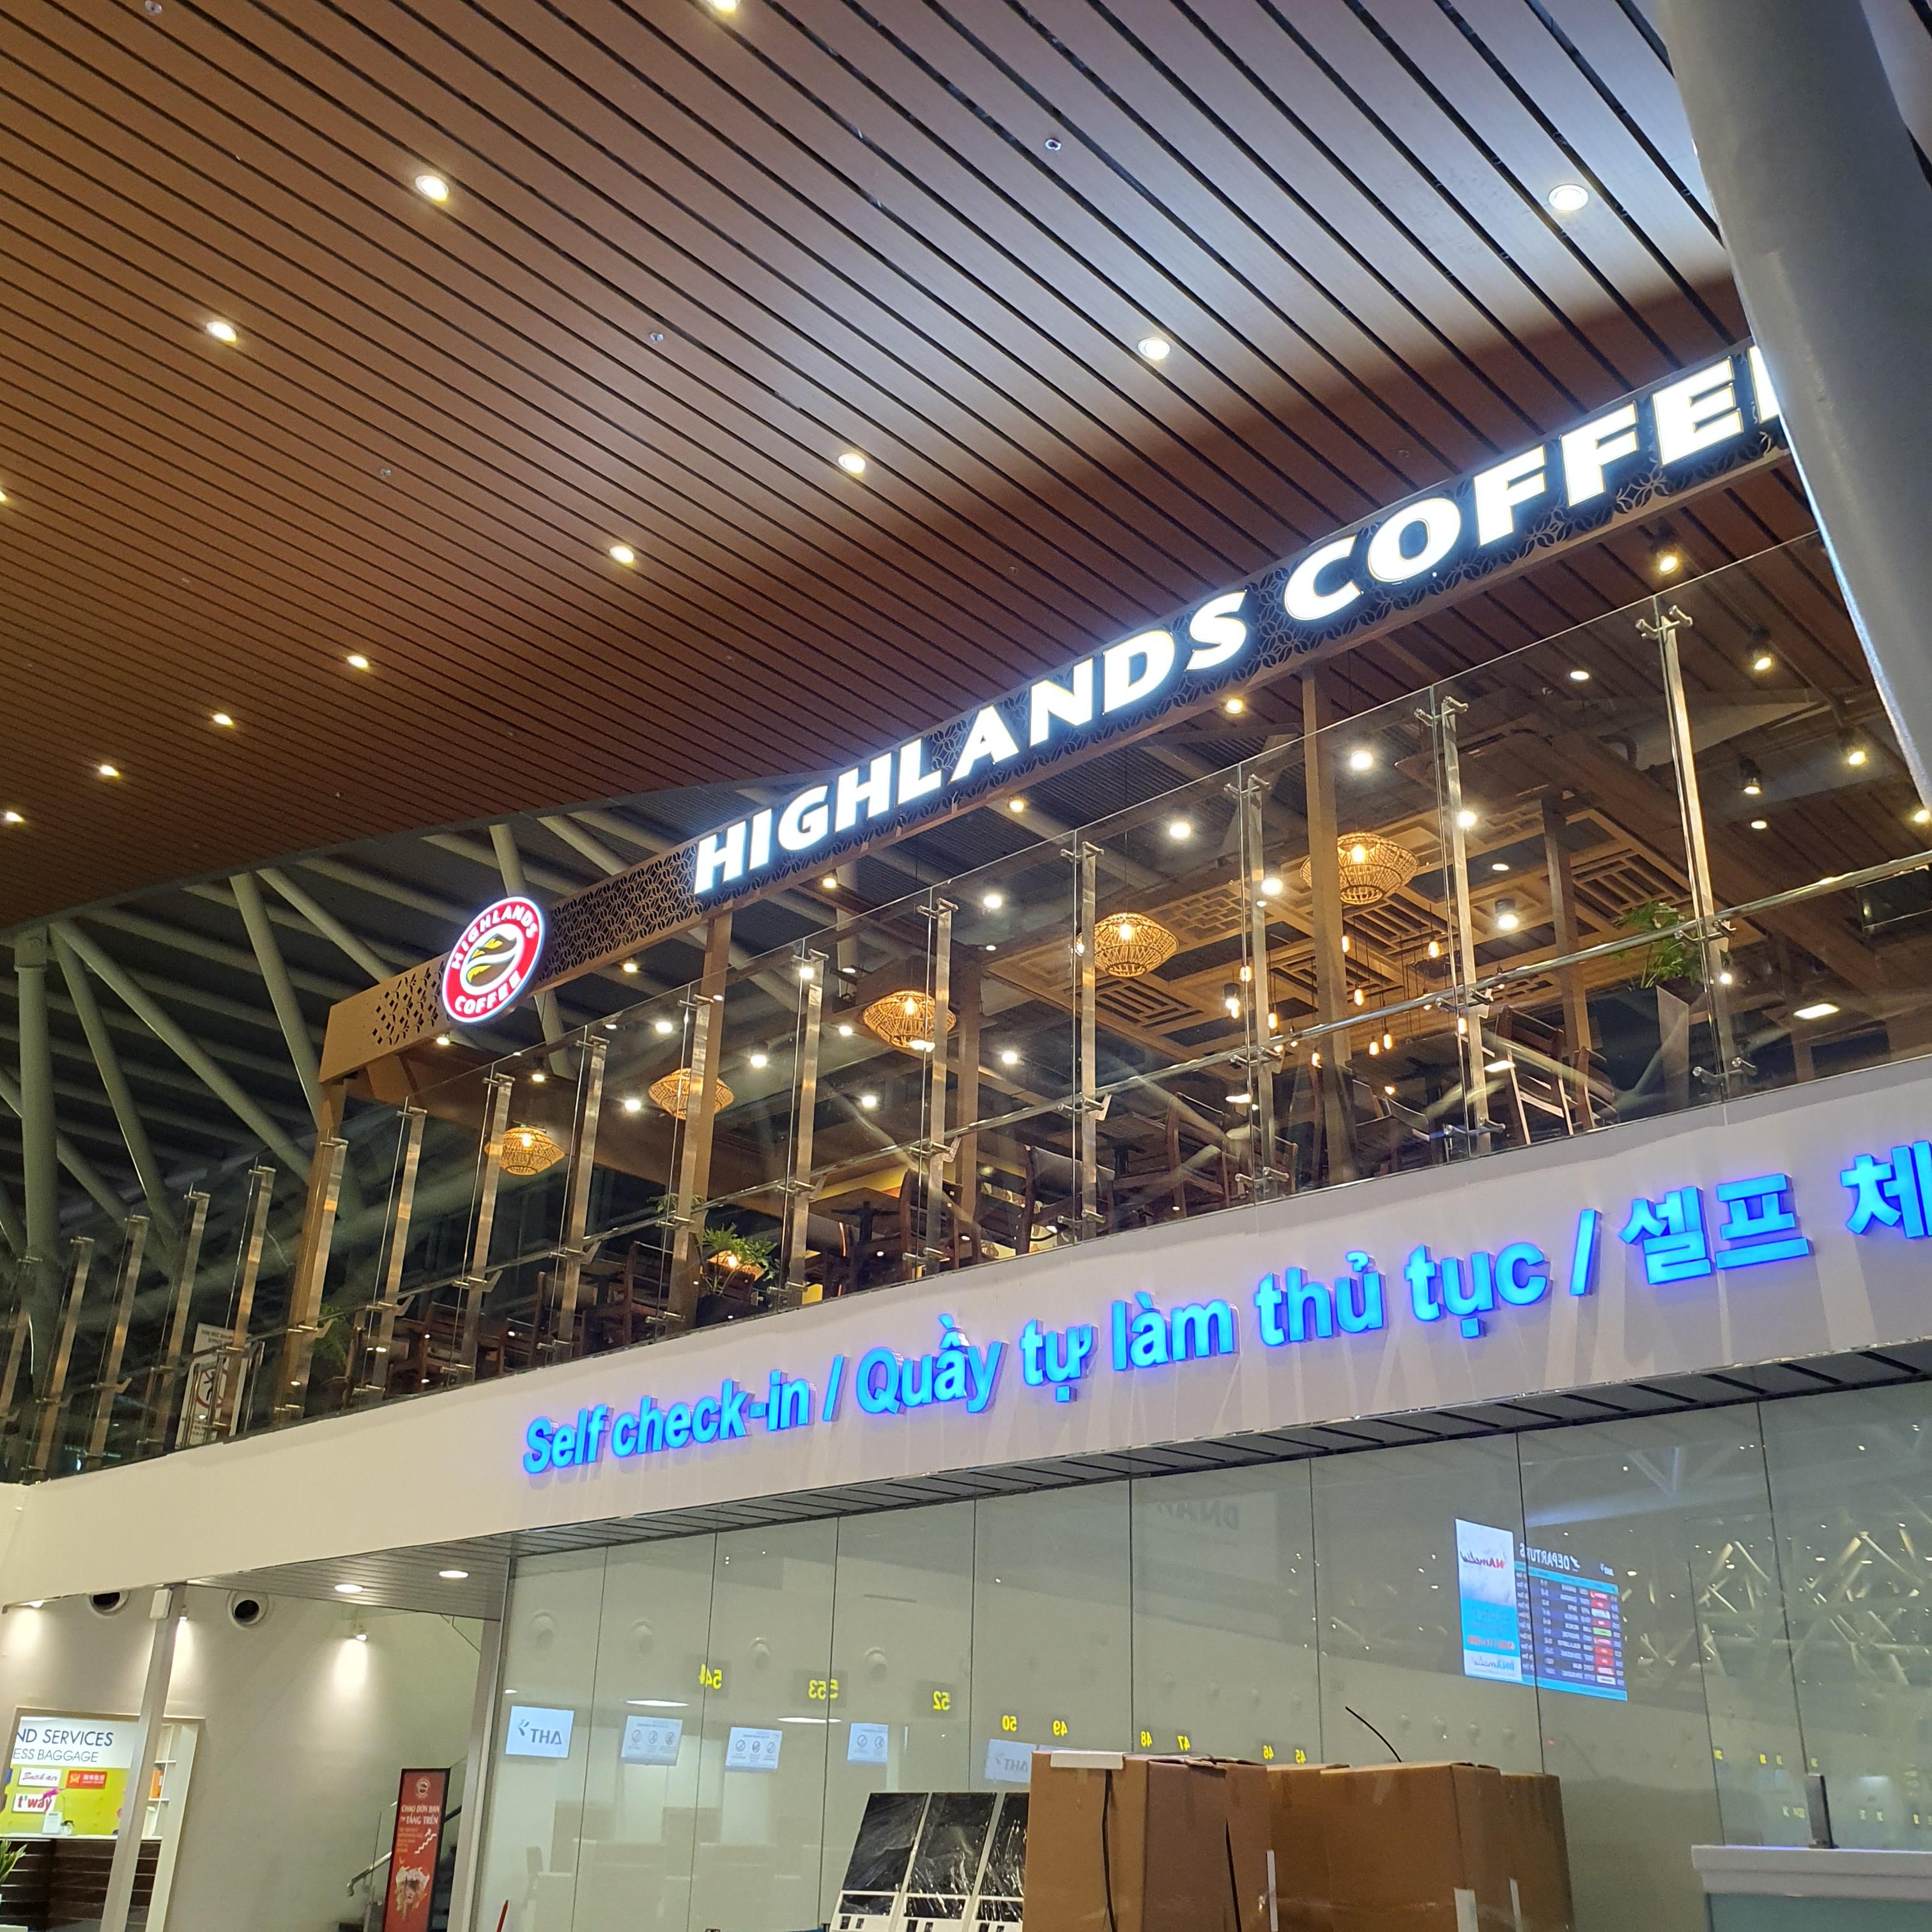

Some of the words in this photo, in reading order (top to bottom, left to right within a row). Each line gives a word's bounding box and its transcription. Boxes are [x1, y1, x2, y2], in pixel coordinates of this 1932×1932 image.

[694, 590, 1247, 894] HIGHLANDS
[452, 905, 539, 970] HIGHLANDS
[455, 971, 522, 1015] COFFEE
[523, 1404, 610, 1473] Self
[611, 1369, 814, 1457] check-in
[822, 1354, 845, 1422] /
[855, 1314, 1006, 1414] Quầy
[1020, 1319, 1096, 1403] tự
[1112, 1291, 1237, 1371] làm
[1254, 1251, 1385, 1347] thủ
[1404, 1243, 1550, 1338] tục
[1569, 1209, 1598, 1296] /
[1618, 1173, 1811, 1285] 셀프
[13, 1748, 35, 1759] ESS
[37, 1749, 99, 1762] BAGGAGE
[43, 1729, 114, 1746] SERVICES
